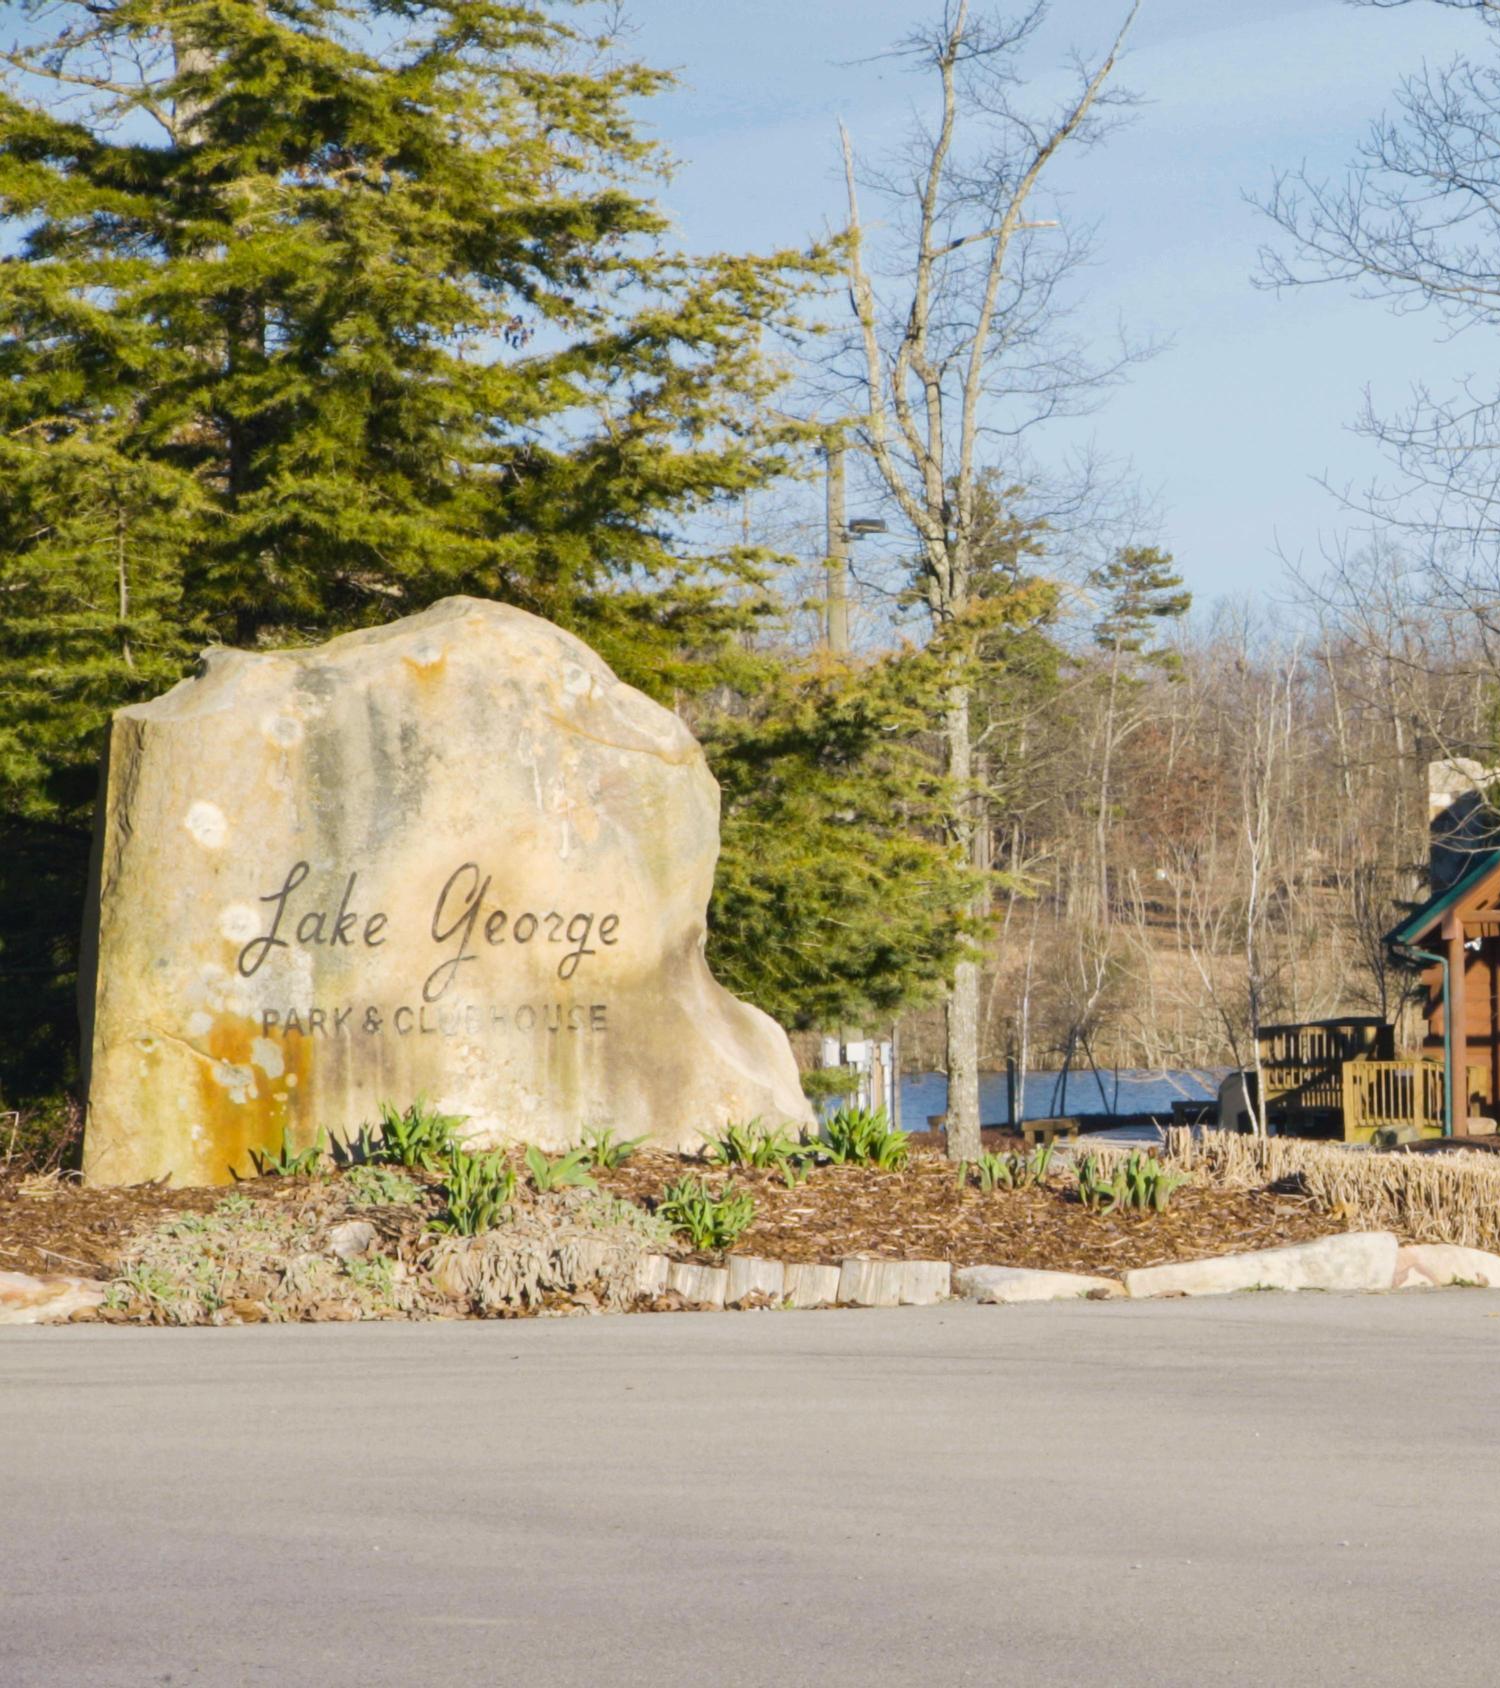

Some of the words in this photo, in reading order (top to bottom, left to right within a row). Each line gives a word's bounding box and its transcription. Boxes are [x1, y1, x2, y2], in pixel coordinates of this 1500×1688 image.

[238, 861, 388, 977] Lake
[422, 862, 620, 1003] George
[261, 1006, 352, 1038] PARK
[362, 1006, 384, 1035] &
